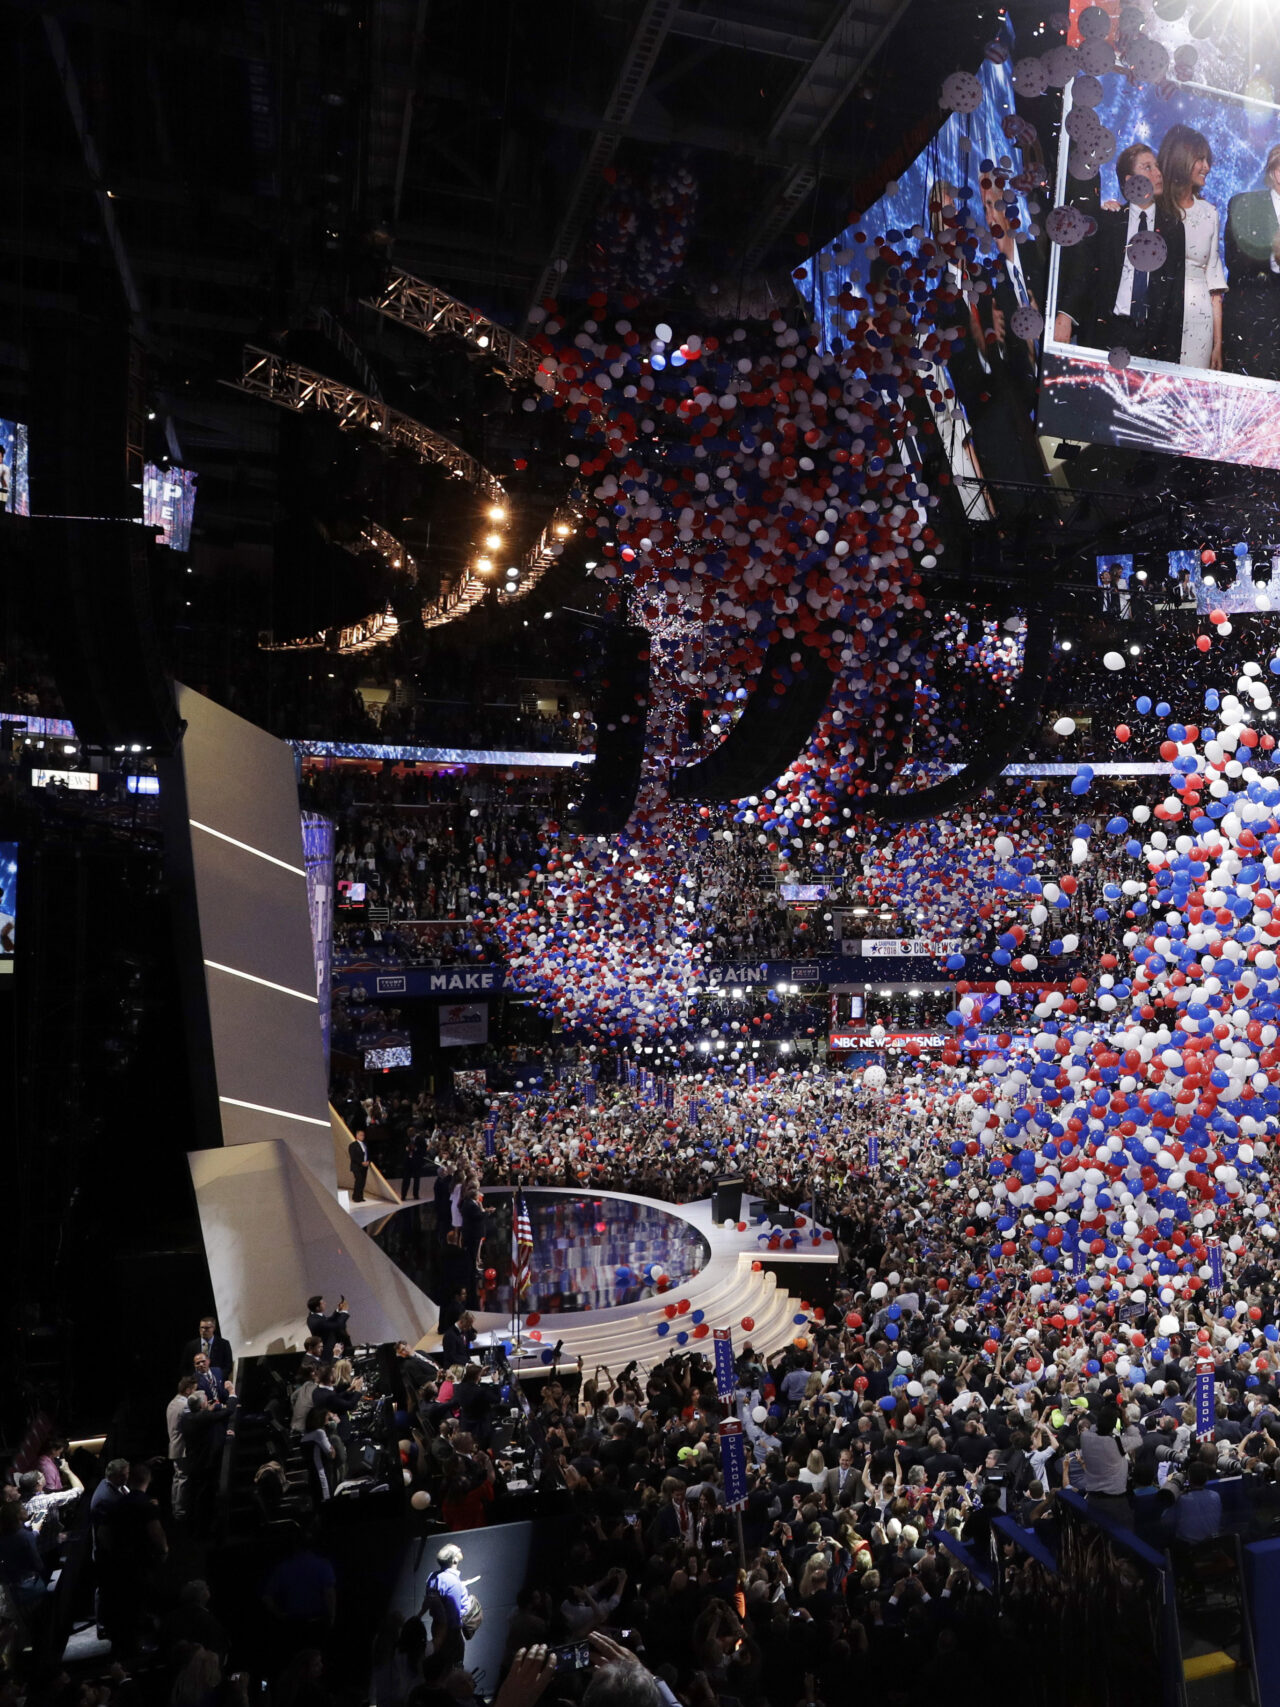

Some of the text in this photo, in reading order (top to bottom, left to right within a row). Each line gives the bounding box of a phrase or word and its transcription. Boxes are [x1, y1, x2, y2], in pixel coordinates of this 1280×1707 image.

[430, 973, 494, 991] MAKE
[694, 967, 768, 983] AGAIN!
[832, 1037, 858, 1048] NBC
[860, 1037, 892, 1048] NEWS
[718, 1341, 727, 1389] ALABAMA
[728, 1436, 741, 1496] OKLAHOMA
